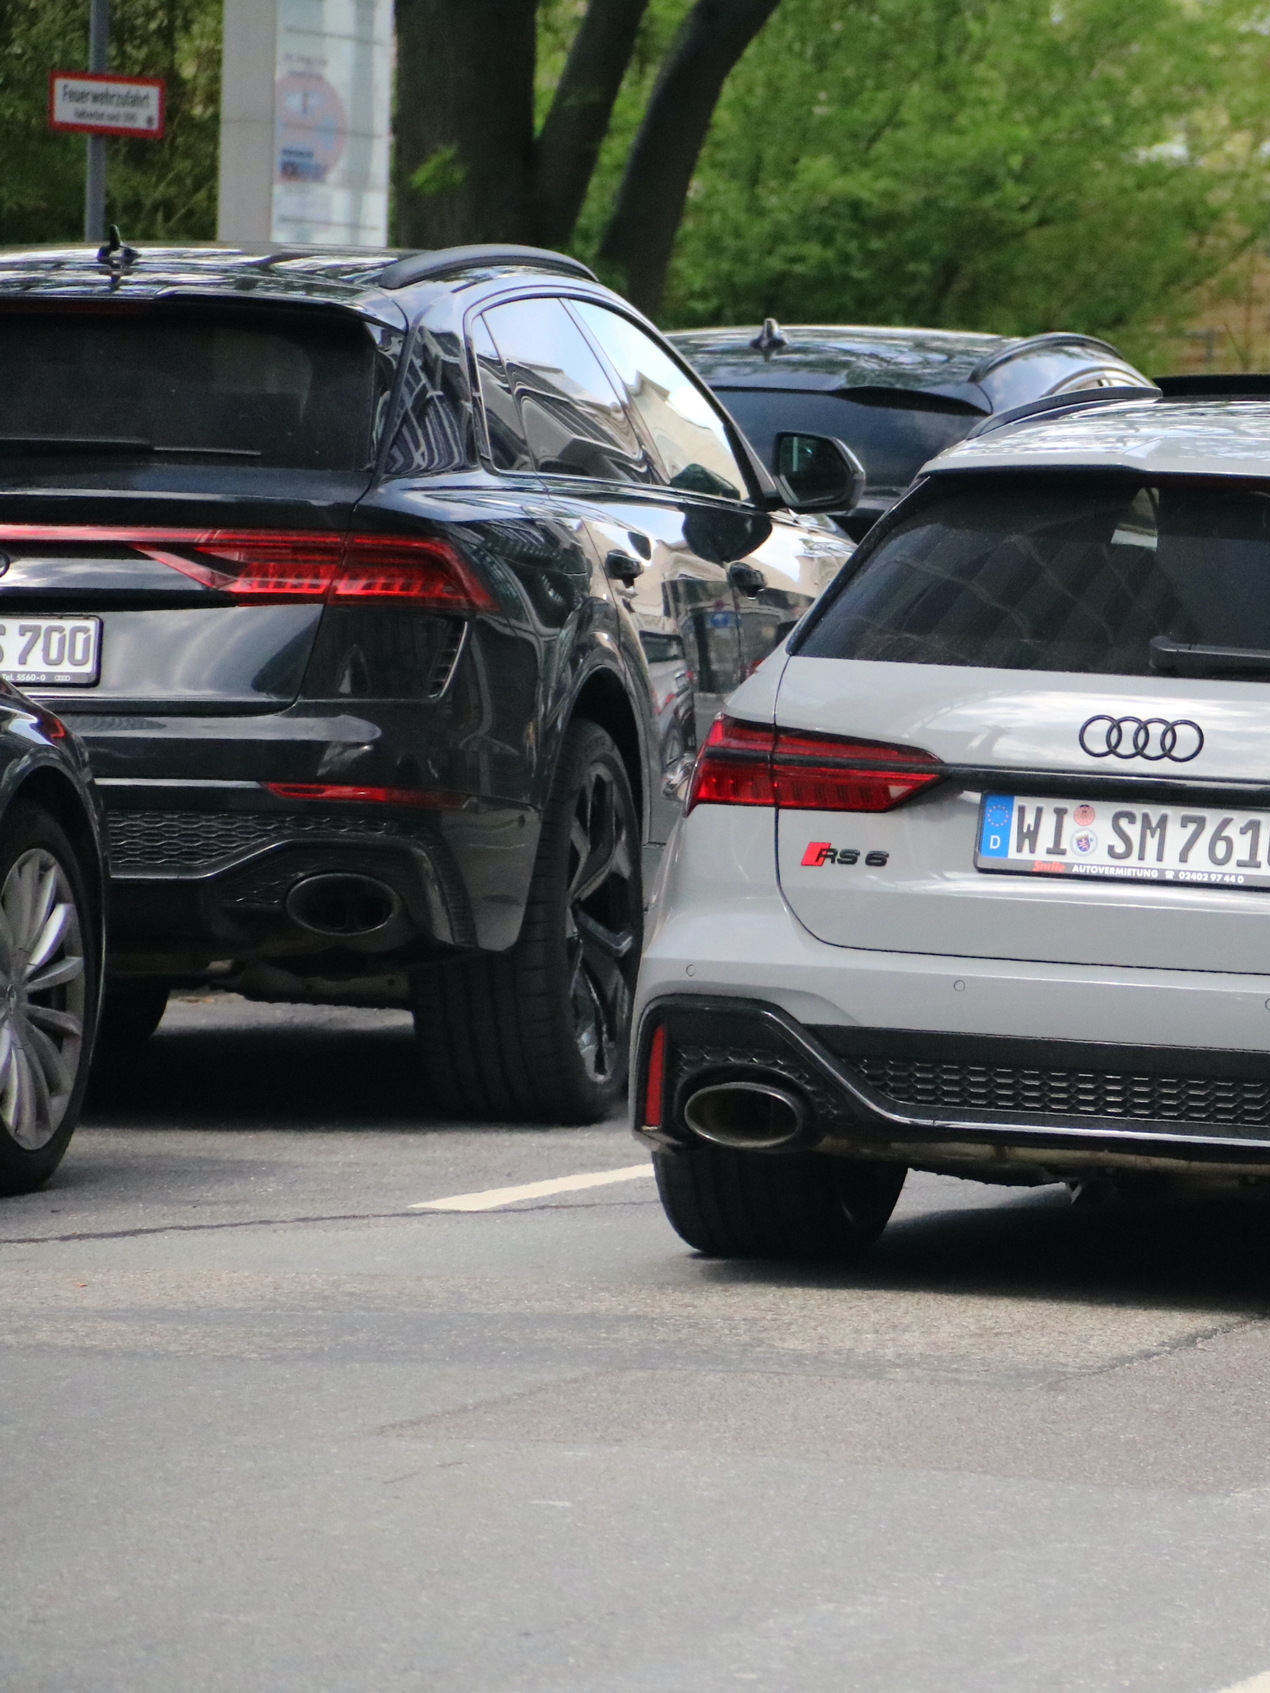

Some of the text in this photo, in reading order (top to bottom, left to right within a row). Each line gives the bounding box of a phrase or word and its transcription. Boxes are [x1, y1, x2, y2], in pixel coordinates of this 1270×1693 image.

[62, 83, 150, 109] Feuerwehrzufahrt
[17, 623, 92, 667] 700
[989, 834, 1001, 849] D
[1072, 864, 1159, 879] AUTOVERMIETUNG
